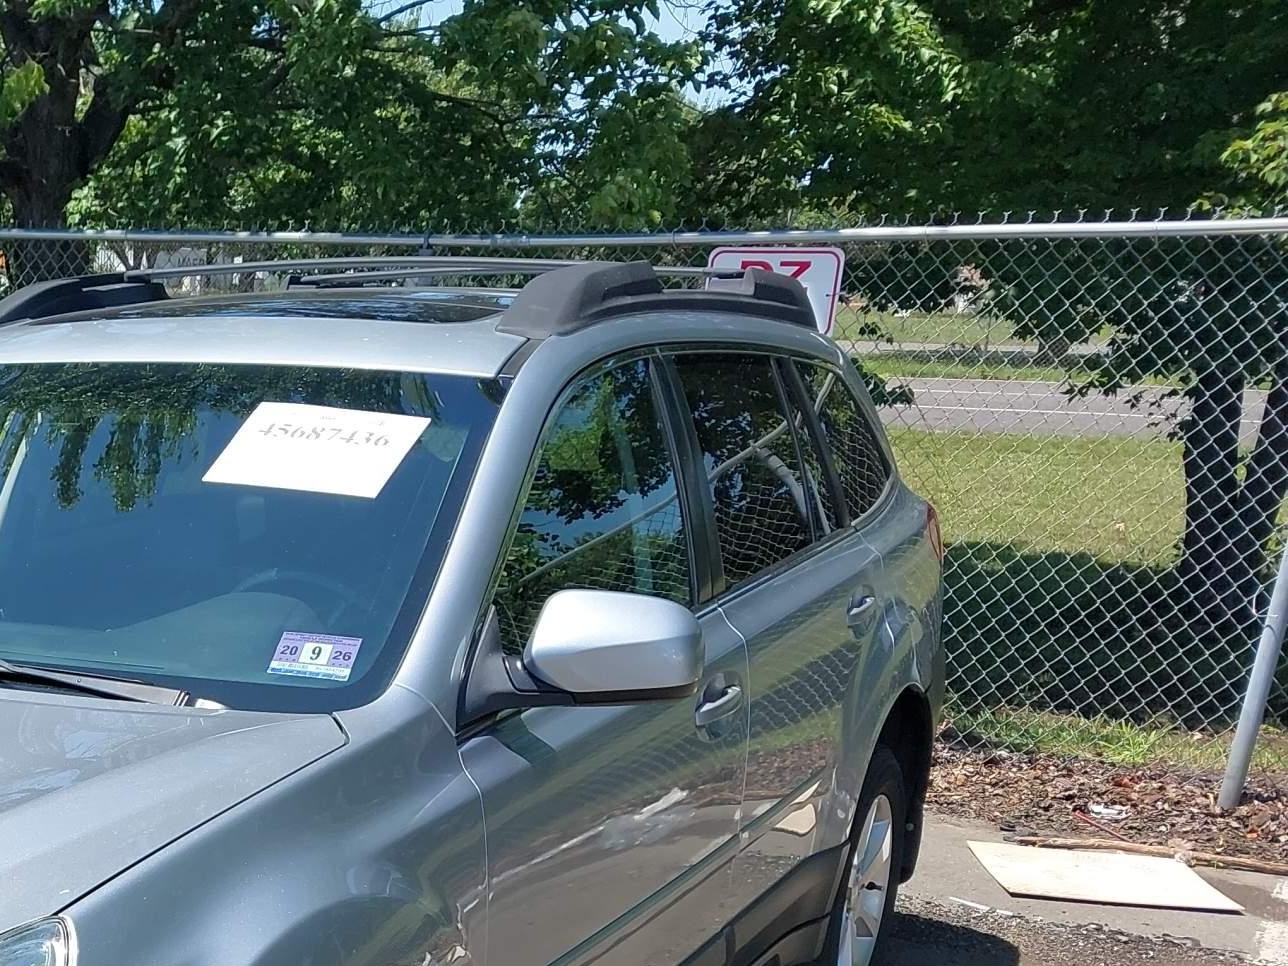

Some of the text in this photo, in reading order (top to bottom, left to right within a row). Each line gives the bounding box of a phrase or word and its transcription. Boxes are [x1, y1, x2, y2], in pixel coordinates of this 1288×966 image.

[258, 423, 391, 447] 45687436
[279, 645, 353, 661] 20 9 26
